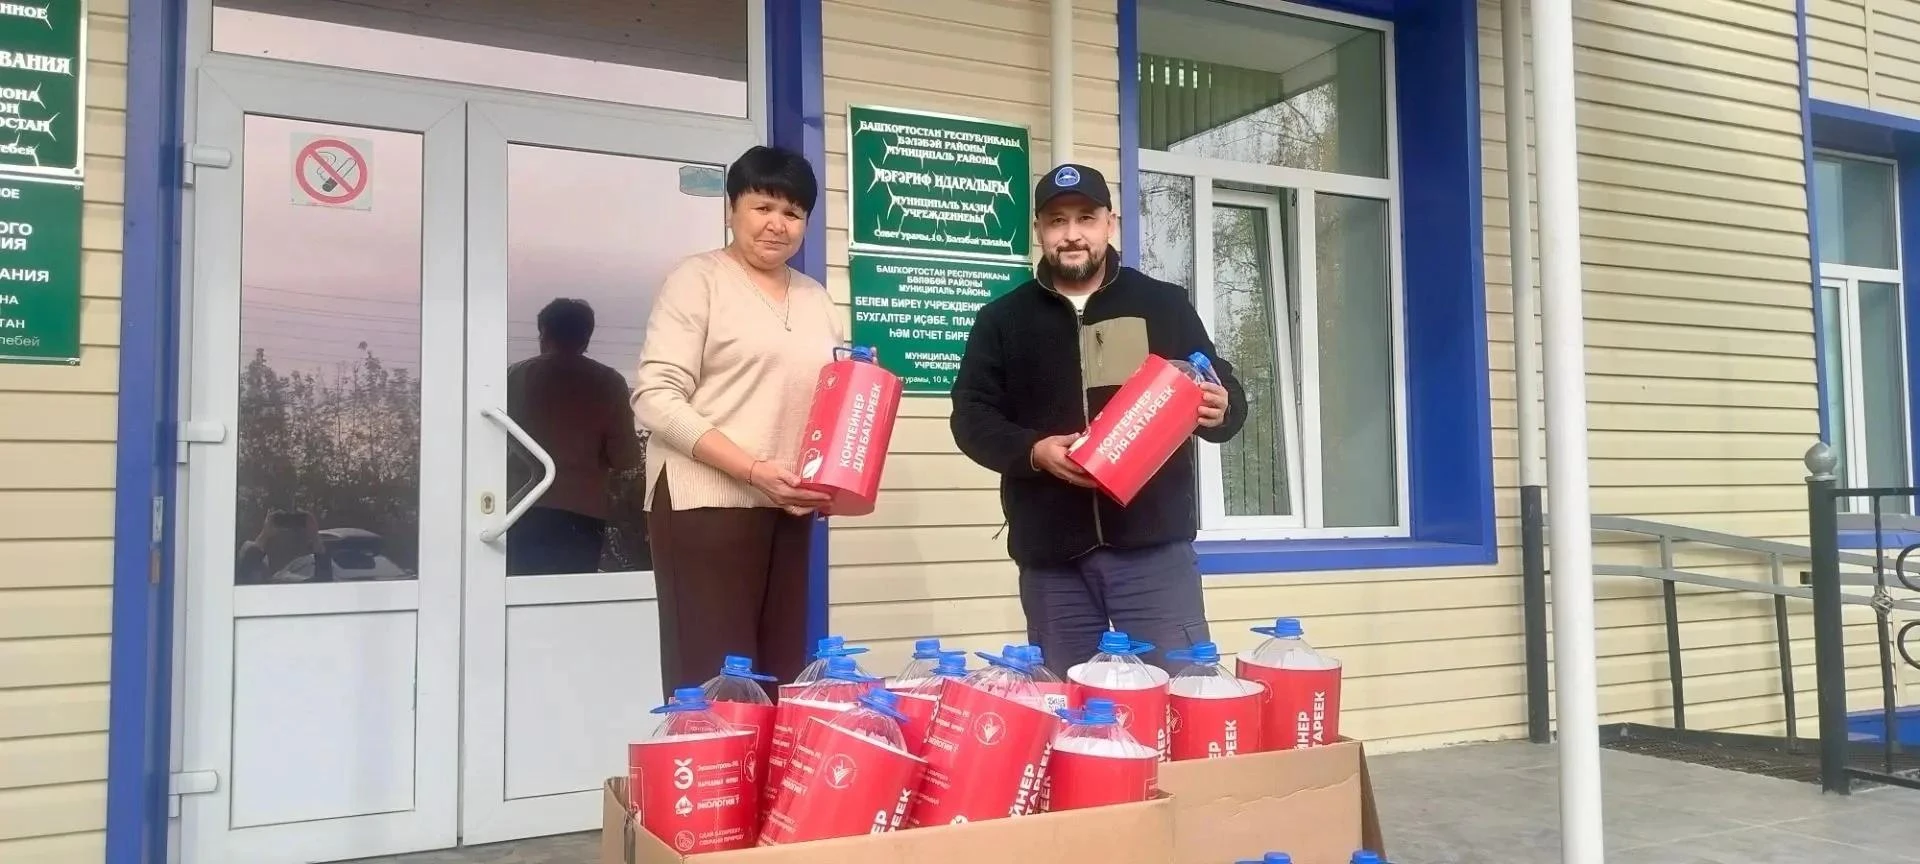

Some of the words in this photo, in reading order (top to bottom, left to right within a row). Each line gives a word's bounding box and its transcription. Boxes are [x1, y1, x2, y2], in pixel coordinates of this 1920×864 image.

[855, 296, 889, 308] БЕЛЕМ
[856, 311, 911, 324] БУХГАЛТЕР
[912, 329, 943, 341] ОТЧЕТ
[933, 375, 942, 384] 10
[840, 393, 865, 468] КОНТЕЙНЕР
[854, 442, 867, 473] ДЛЯ
[862, 383, 882, 444] БАТАРЕЕК
[1096, 390, 1153, 456] КОНТЕЙНЕР
[1106, 438, 1131, 465] ДЛЯ
[1127, 384, 1176, 440] БАТАРЕЕК
